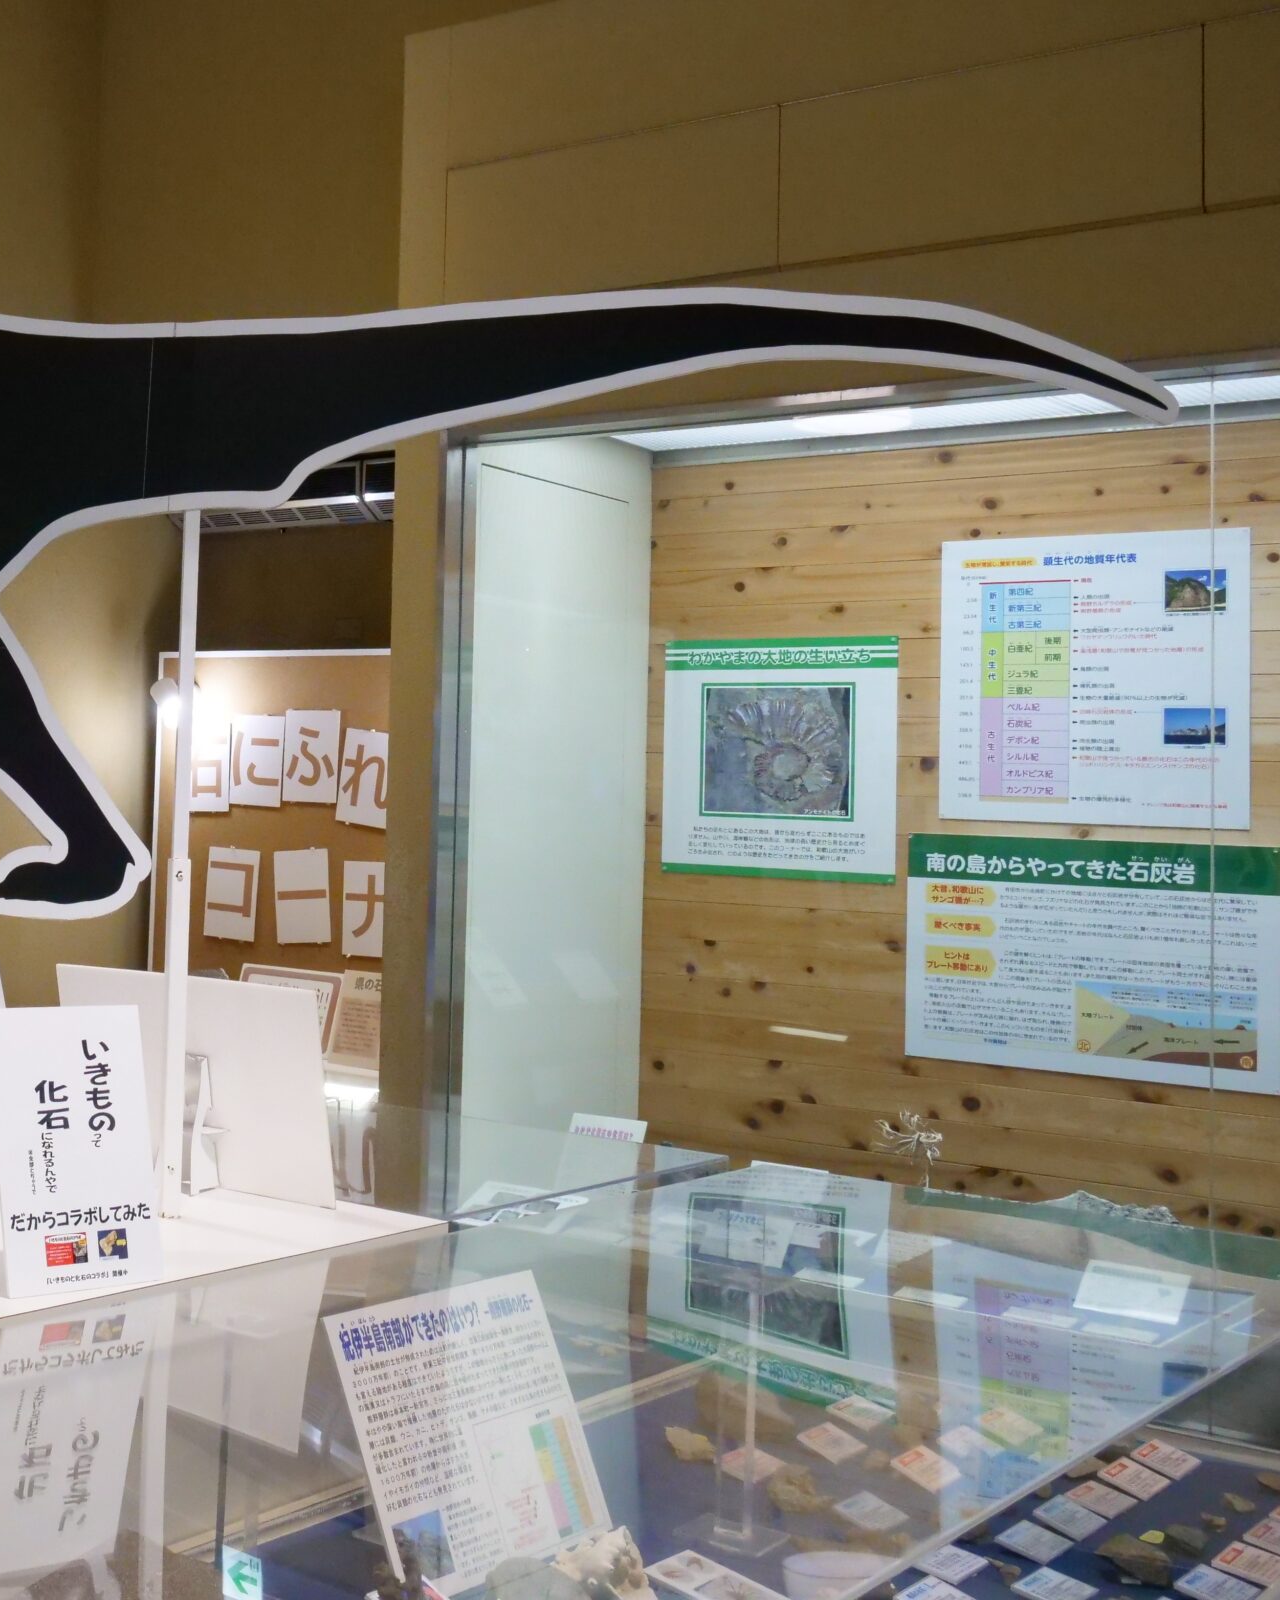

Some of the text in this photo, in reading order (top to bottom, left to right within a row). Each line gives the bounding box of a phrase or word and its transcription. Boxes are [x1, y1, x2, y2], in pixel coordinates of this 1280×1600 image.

[1043, 553, 1137, 566] 顕生代の地質年代表
[1008, 588, 1034, 596] 第四紀
[988, 592, 997, 624] 新生代
[1008, 604, 1041, 612] 新第三紀
[1008, 621, 1041, 629] 古第三紀
[1045, 637, 1061, 645] 後期
[1008, 645, 1032, 653] 白亜紀
[687, 647, 872, 666] わかやまの大地の生い立ち
[1045, 654, 1061, 662] 前期
[988, 649, 997, 680] 中生代
[1008, 670, 1038, 679] ジュラ紀
[1007, 720, 1032, 728] 石炭紀
[1007, 736, 1039, 744] デボン紀
[987, 731, 995, 762] 古生代
[1007, 753, 1039, 761] シルル紀
[1007, 770, 1053, 778] オルドビス紀
[1006, 786, 1053, 795] カンブリア紀
[926, 852, 1196, 885] 南の島からやってきた石灰岩
[207, 861, 385, 938] コーナ
[944, 951, 970, 961] ヒントは
[927, 961, 988, 973] プレート移動にあり
[81, 1039, 116, 1148] いきものって
[34, 1079, 70, 1193] 化石になれるんやで
[10, 1202, 151, 1232] だからコラボしてみた
[46, 1271, 109, 1285] 「いきものと化石のコラボ」
[338, 1301, 480, 1362] 紀伊半島南部ができたのはいつ？
